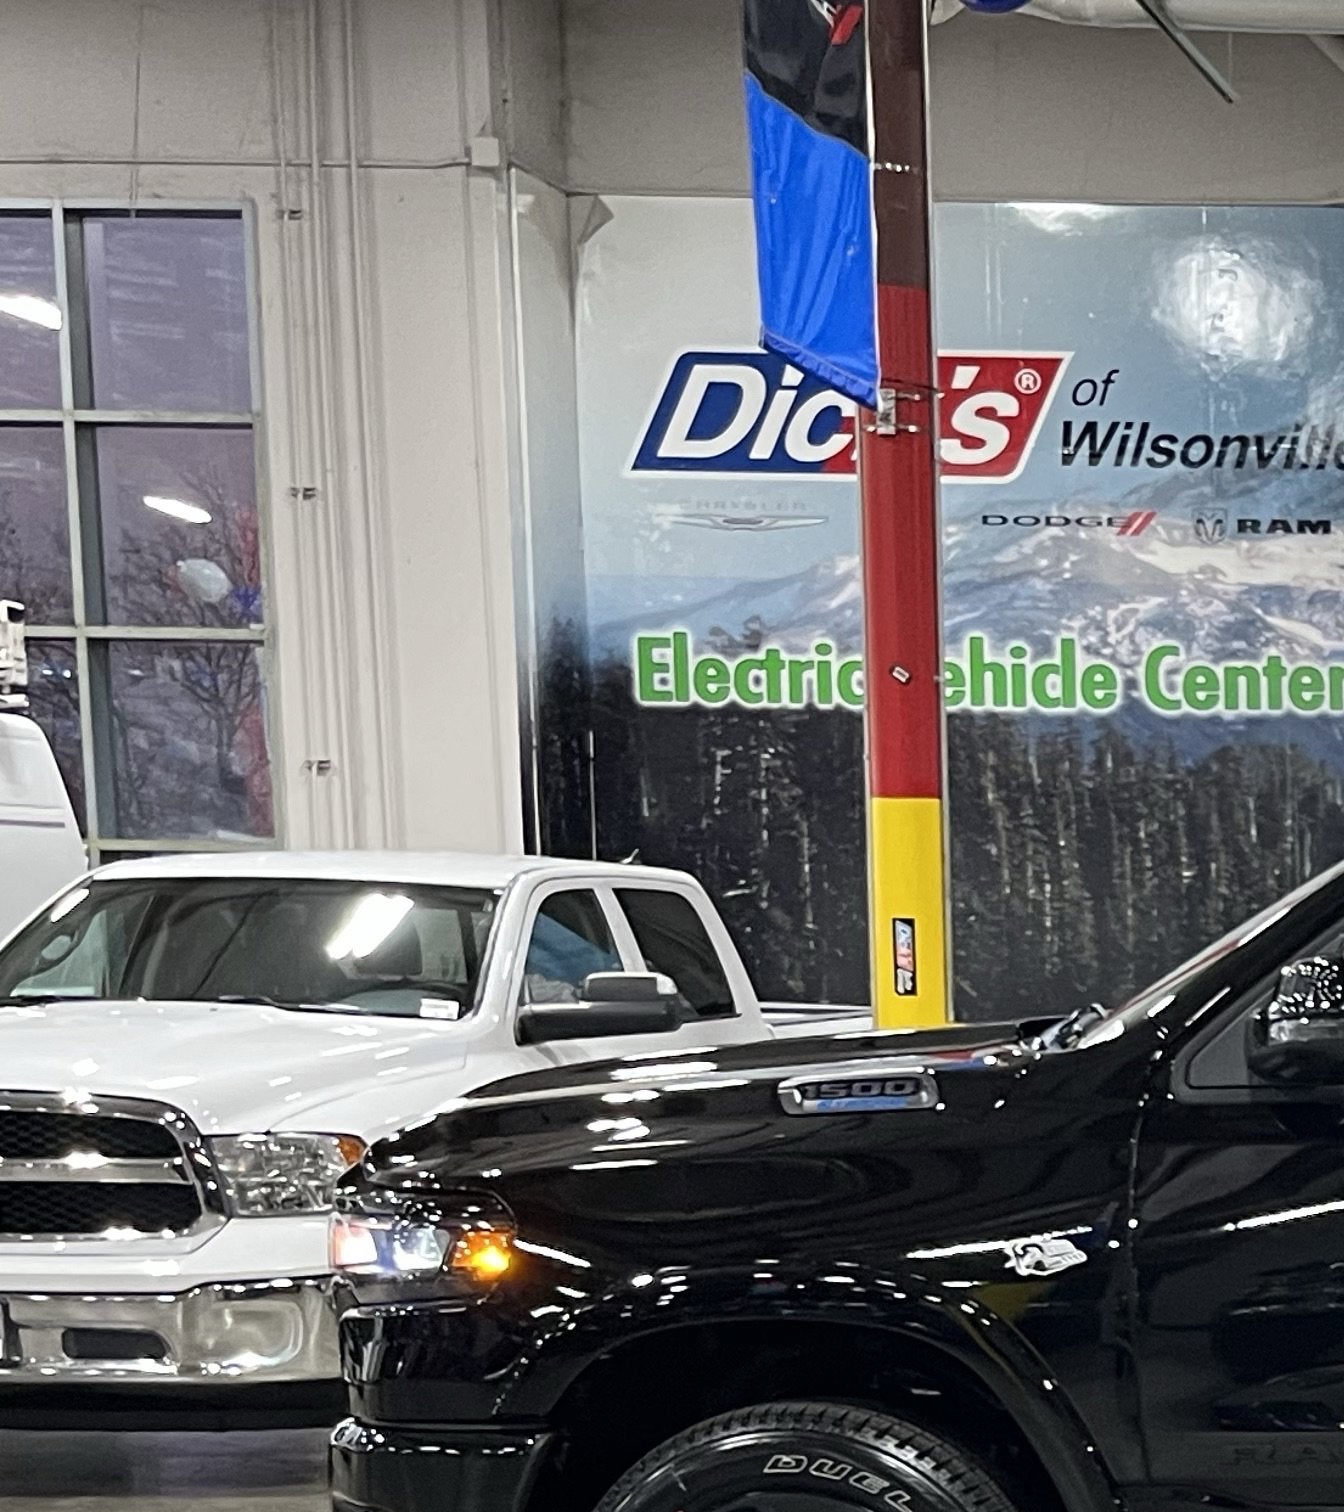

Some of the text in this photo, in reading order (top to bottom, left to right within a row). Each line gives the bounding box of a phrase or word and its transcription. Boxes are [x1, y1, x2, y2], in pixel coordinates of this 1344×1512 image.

[1072, 370, 1119, 406] of
[656, 364, 1020, 466] Dic's
[982, 514, 1134, 528] DODGE
[1236, 519, 1332, 534] RAM
[637, 632, 864, 706] Electric
[944, 636, 1118, 709] ehicle
[802, 1080, 918, 1098] 1500
